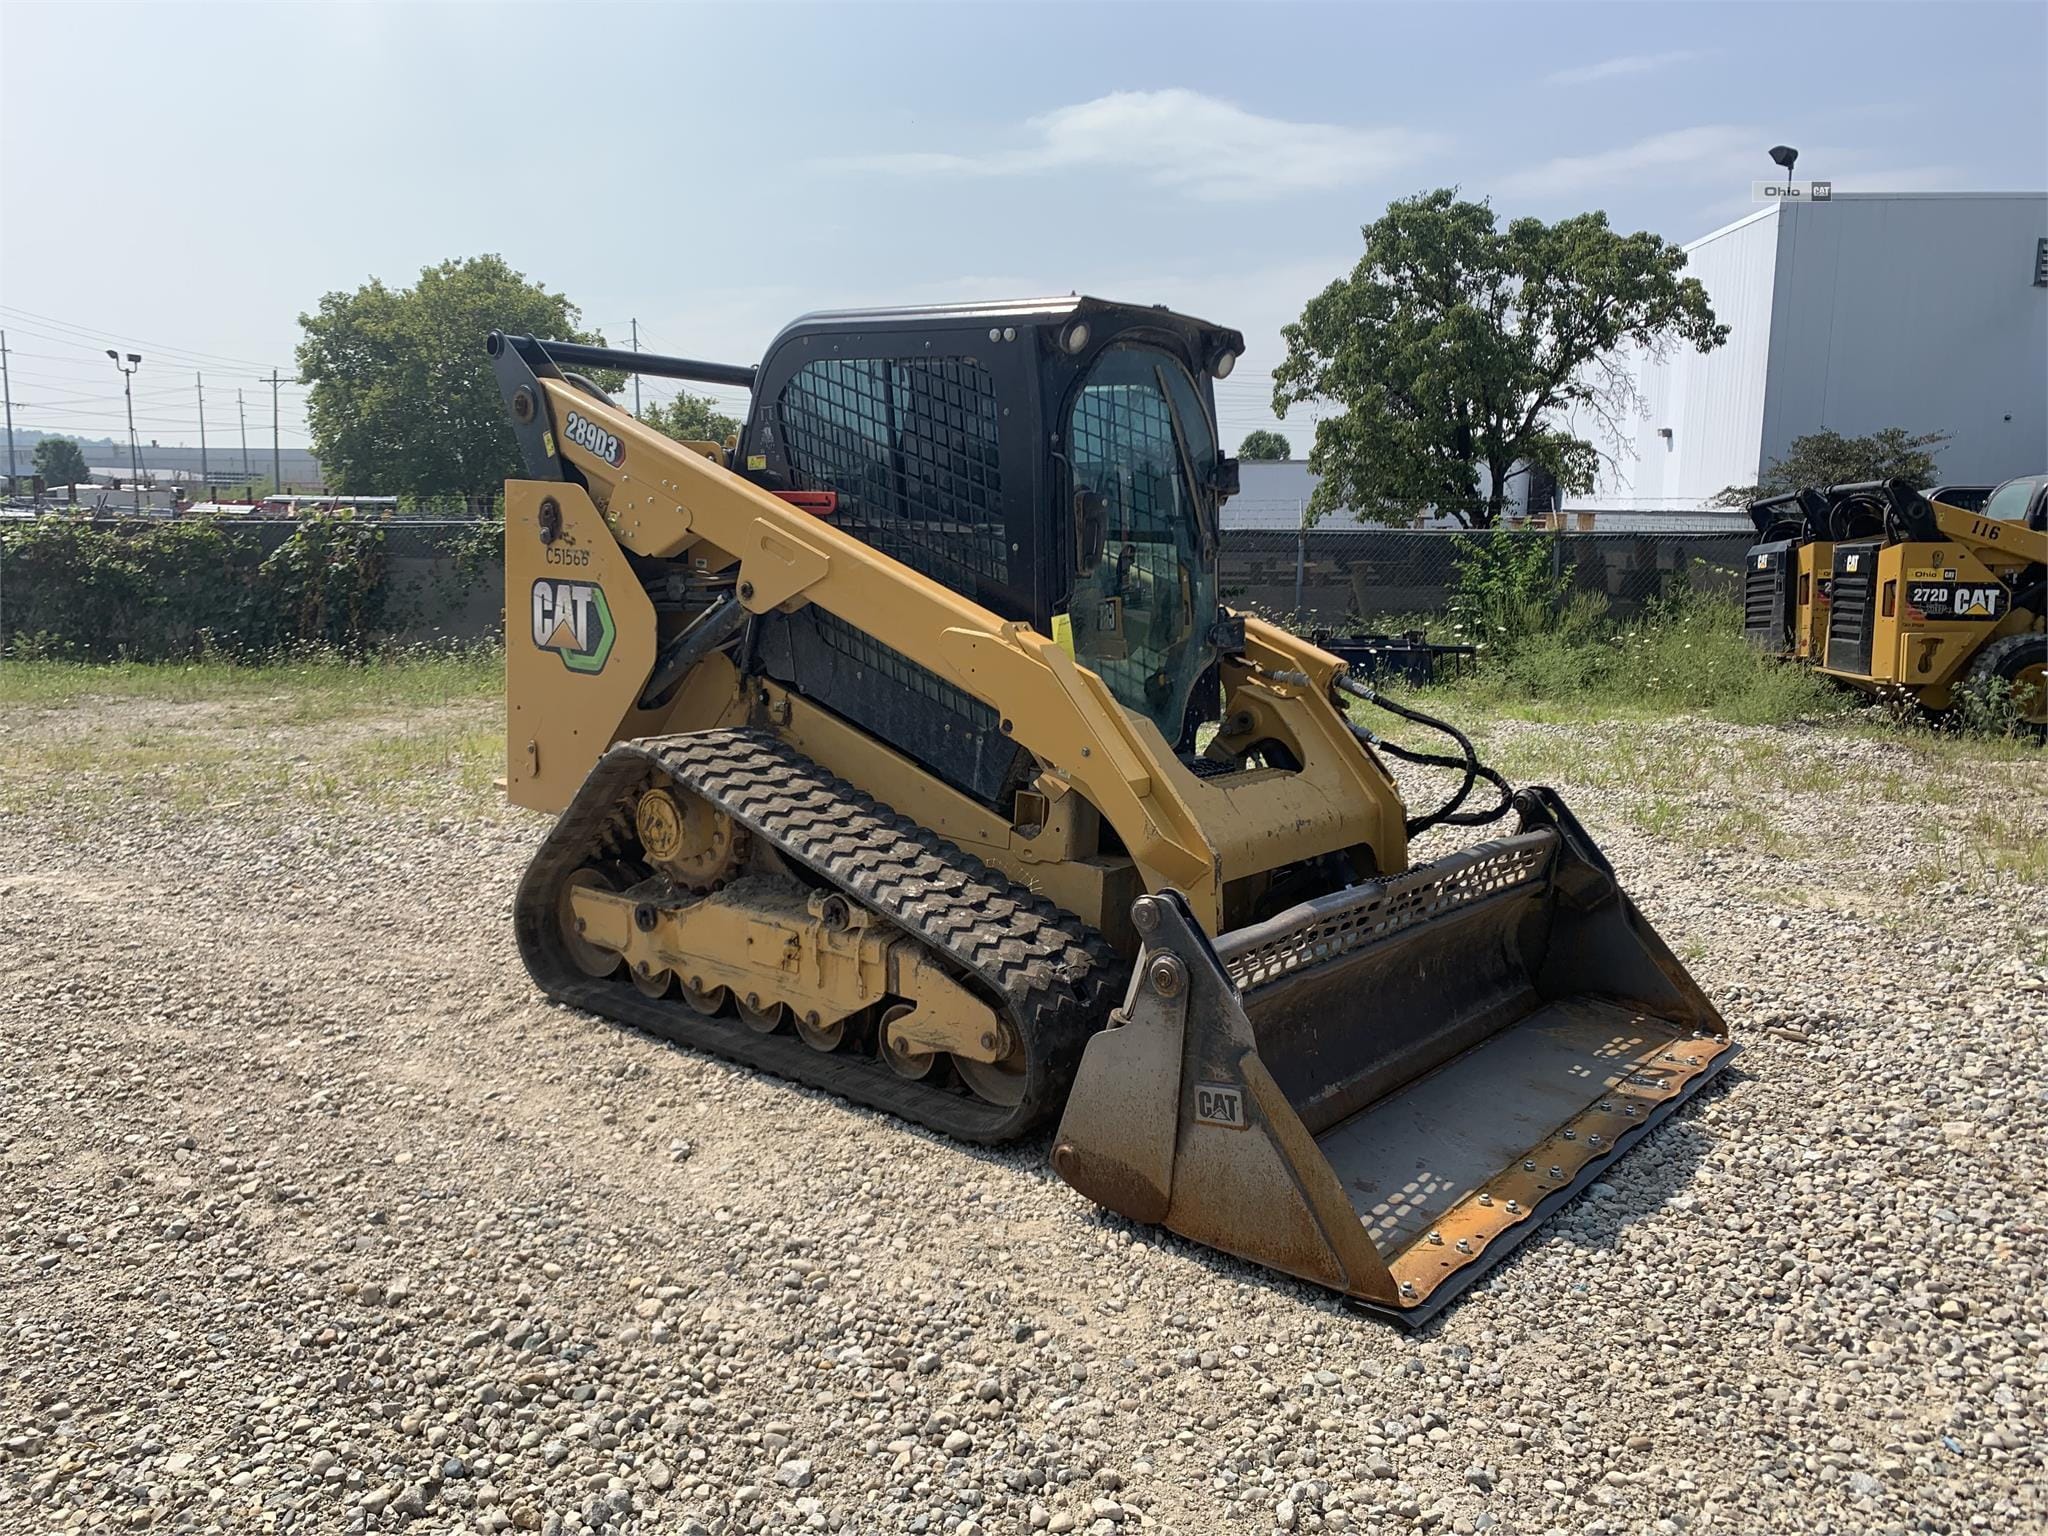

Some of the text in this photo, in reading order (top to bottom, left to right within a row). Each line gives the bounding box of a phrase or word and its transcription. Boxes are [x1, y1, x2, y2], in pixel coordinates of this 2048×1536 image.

[564, 411, 620, 464] 289D3
[1971, 520, 2001, 540] 116
[1846, 555, 1859, 572] CAT
[1944, 571, 1955, 579] CAT
[1913, 588, 1948, 602] 272D
[1954, 588, 2000, 615] CAT
[533, 581, 593, 652] CAT
[1199, 1091, 1238, 1122] CAT
